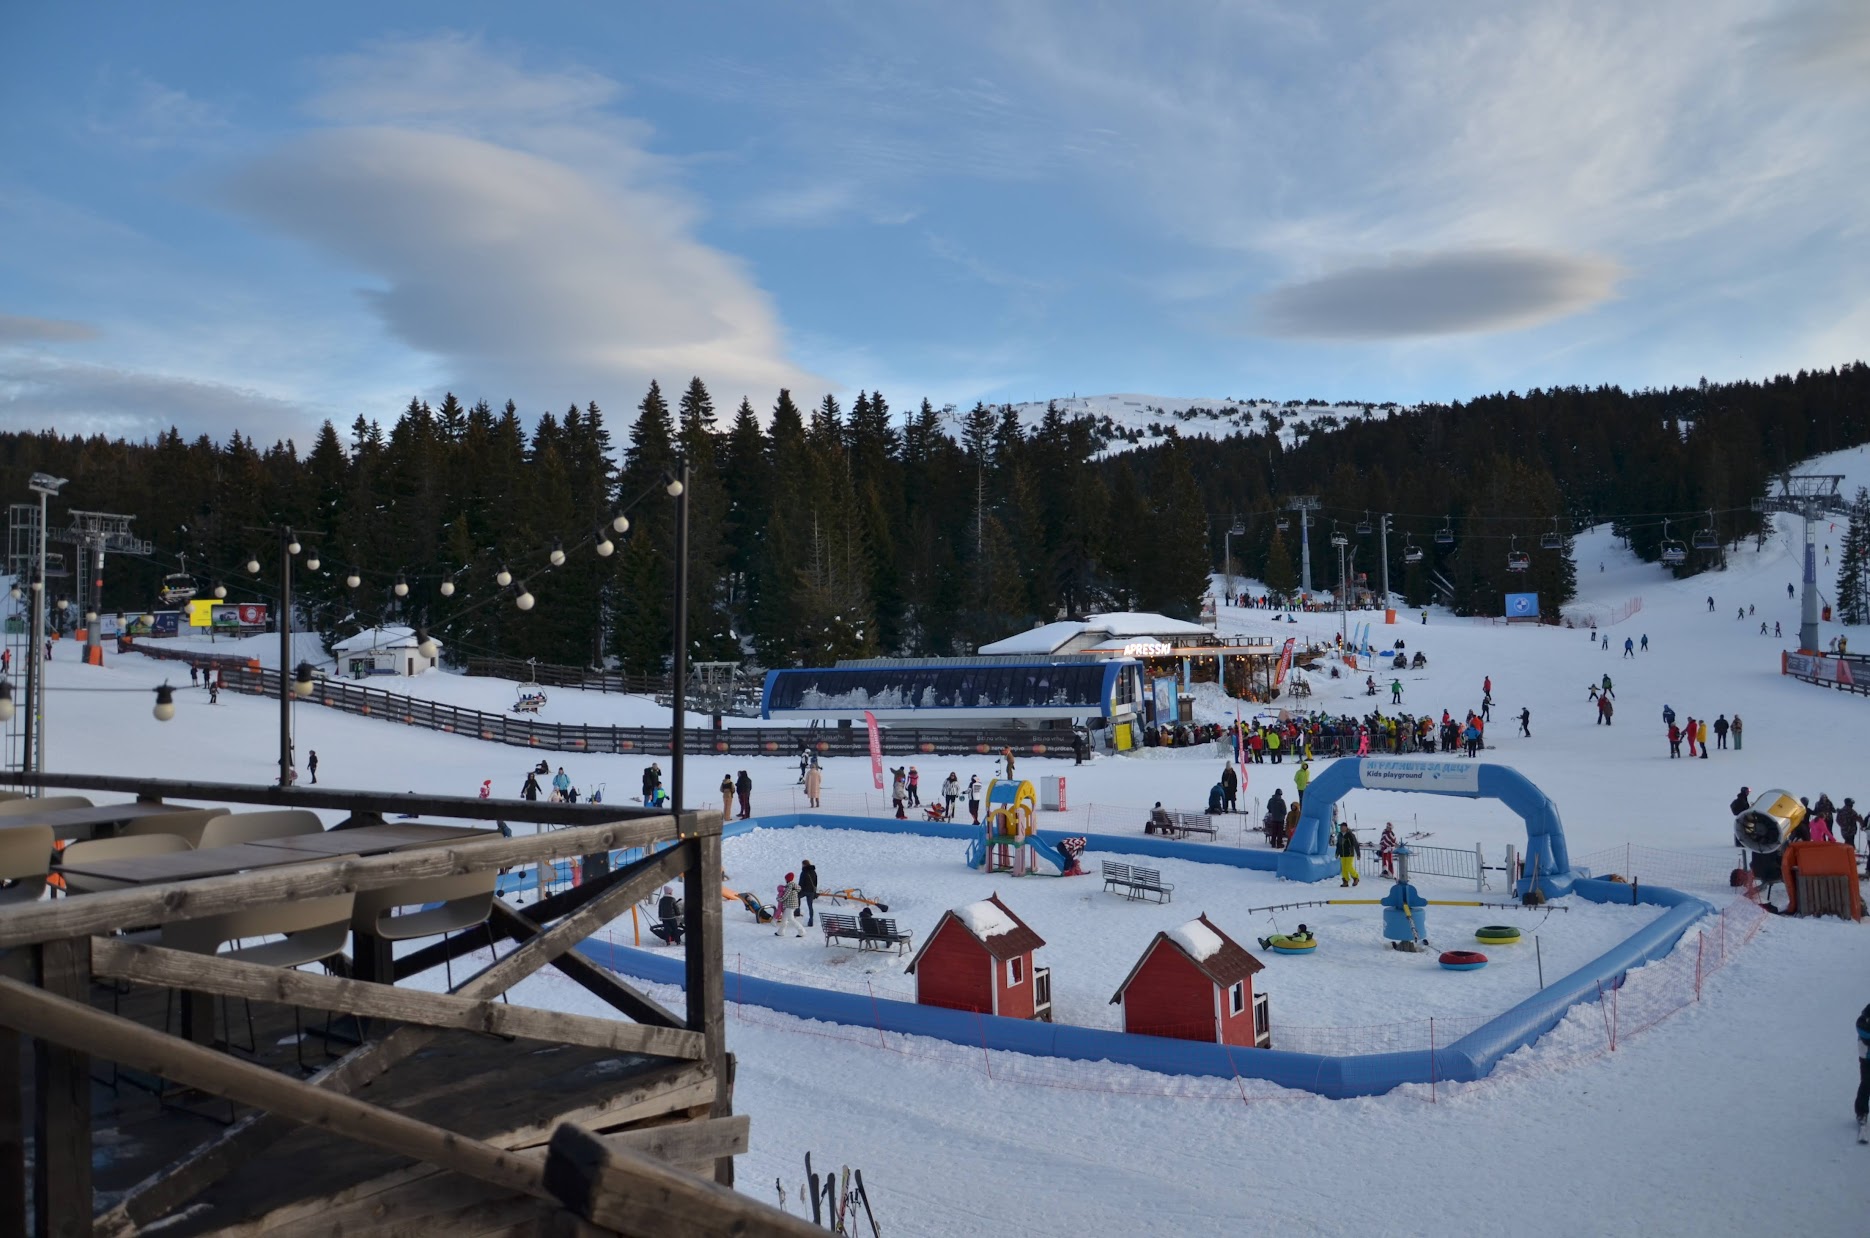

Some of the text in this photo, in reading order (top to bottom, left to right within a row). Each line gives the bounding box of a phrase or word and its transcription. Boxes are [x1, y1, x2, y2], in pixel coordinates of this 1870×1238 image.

[1427, 763, 1441, 772] ЗА
[1442, 763, 1472, 773] ДЕЦУ
[1366, 770, 1423, 779] Kids playground
